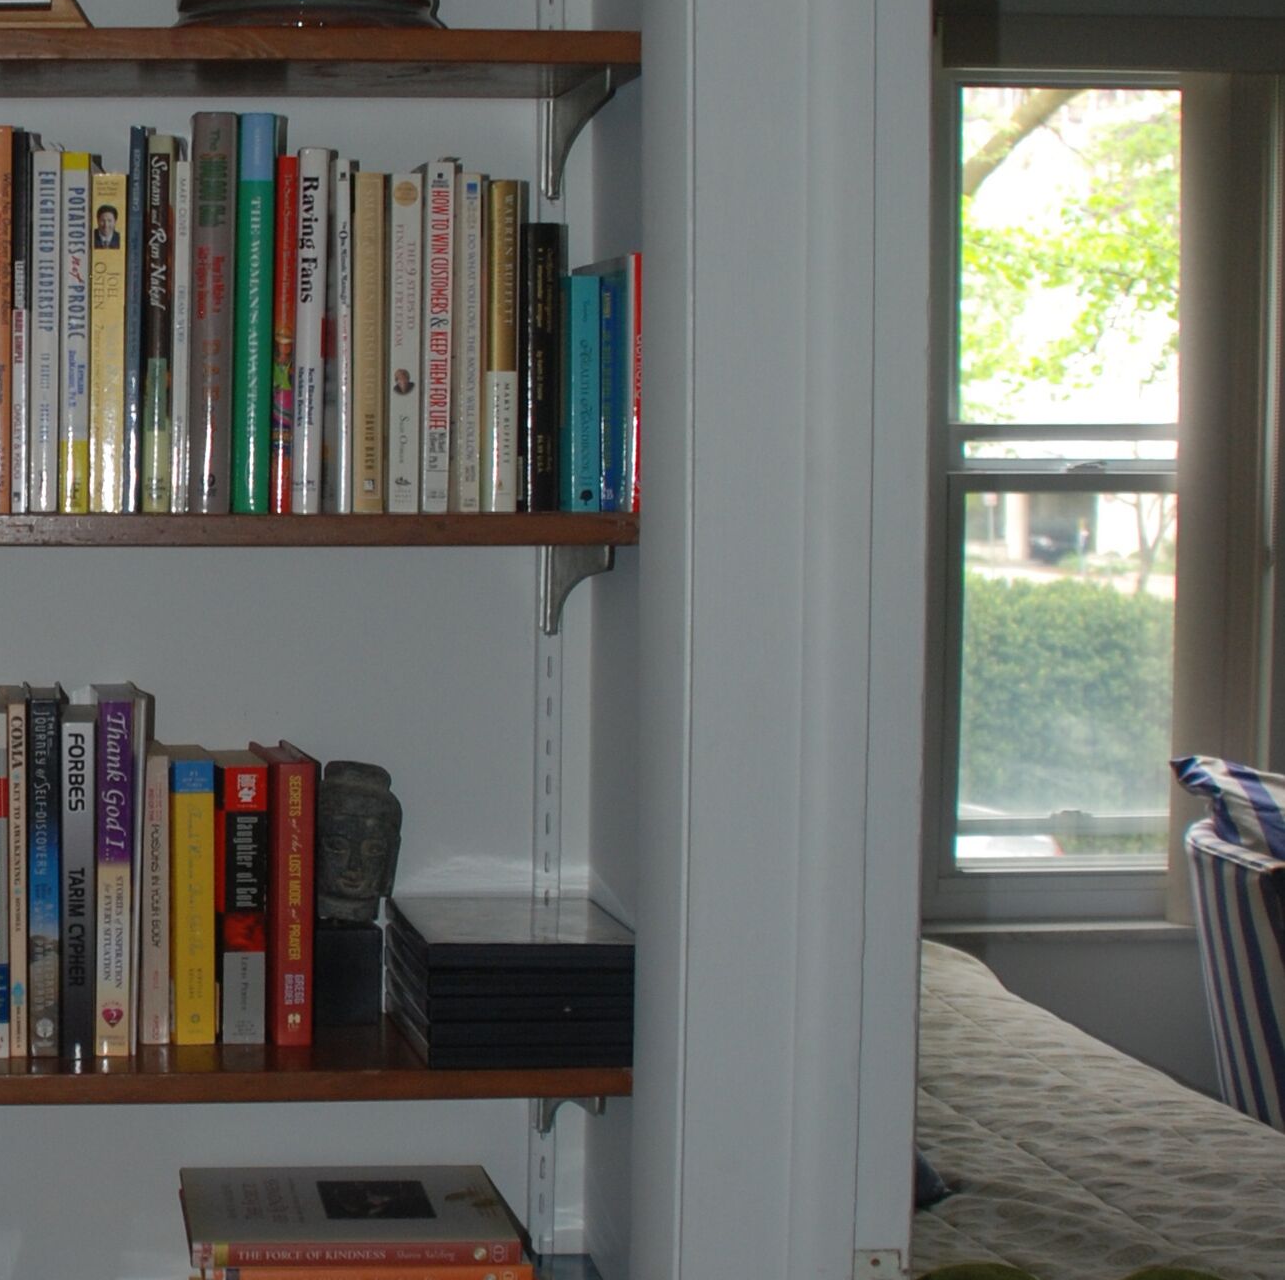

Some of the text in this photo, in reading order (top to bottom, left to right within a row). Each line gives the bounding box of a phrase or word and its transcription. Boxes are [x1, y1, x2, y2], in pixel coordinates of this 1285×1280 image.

[67, 188, 86, 254] POTATOES
[150, 157, 166, 311] Scream and Run Naked
[298, 176, 319, 304] Raving Fans
[38, 171, 55, 333] ENLIGHTENED LEADERSHIP
[503, 194, 515, 325] WARREN BUFFETT
[93, 262, 108, 310] OSTEEN
[106, 272, 120, 298] JOEL
[67, 285, 86, 339] PROZAC
[428, 190, 449, 430] HOW TO WIN CUSTOMERS & KEEP THEM FOR LIFE
[105, 712, 128, 783] Thank
[101, 790, 128, 832] God
[289, 775, 302, 817] SECRETS
[68, 733, 84, 987] FORBES TARIM CYPHER
[234, 816, 257, 869] Daughter
[236, 872, 257, 883] of
[289, 854, 302, 877] LOST
[236, 887, 257, 908] God
[289, 880, 302, 907] MODE
[289, 924, 302, 960] PRAYER
[284, 974, 294, 1005] BRADEN
[293, 974, 304, 1004] GREGG
[237, 1249, 385, 1261] THE FORCE OF KINDNESS
